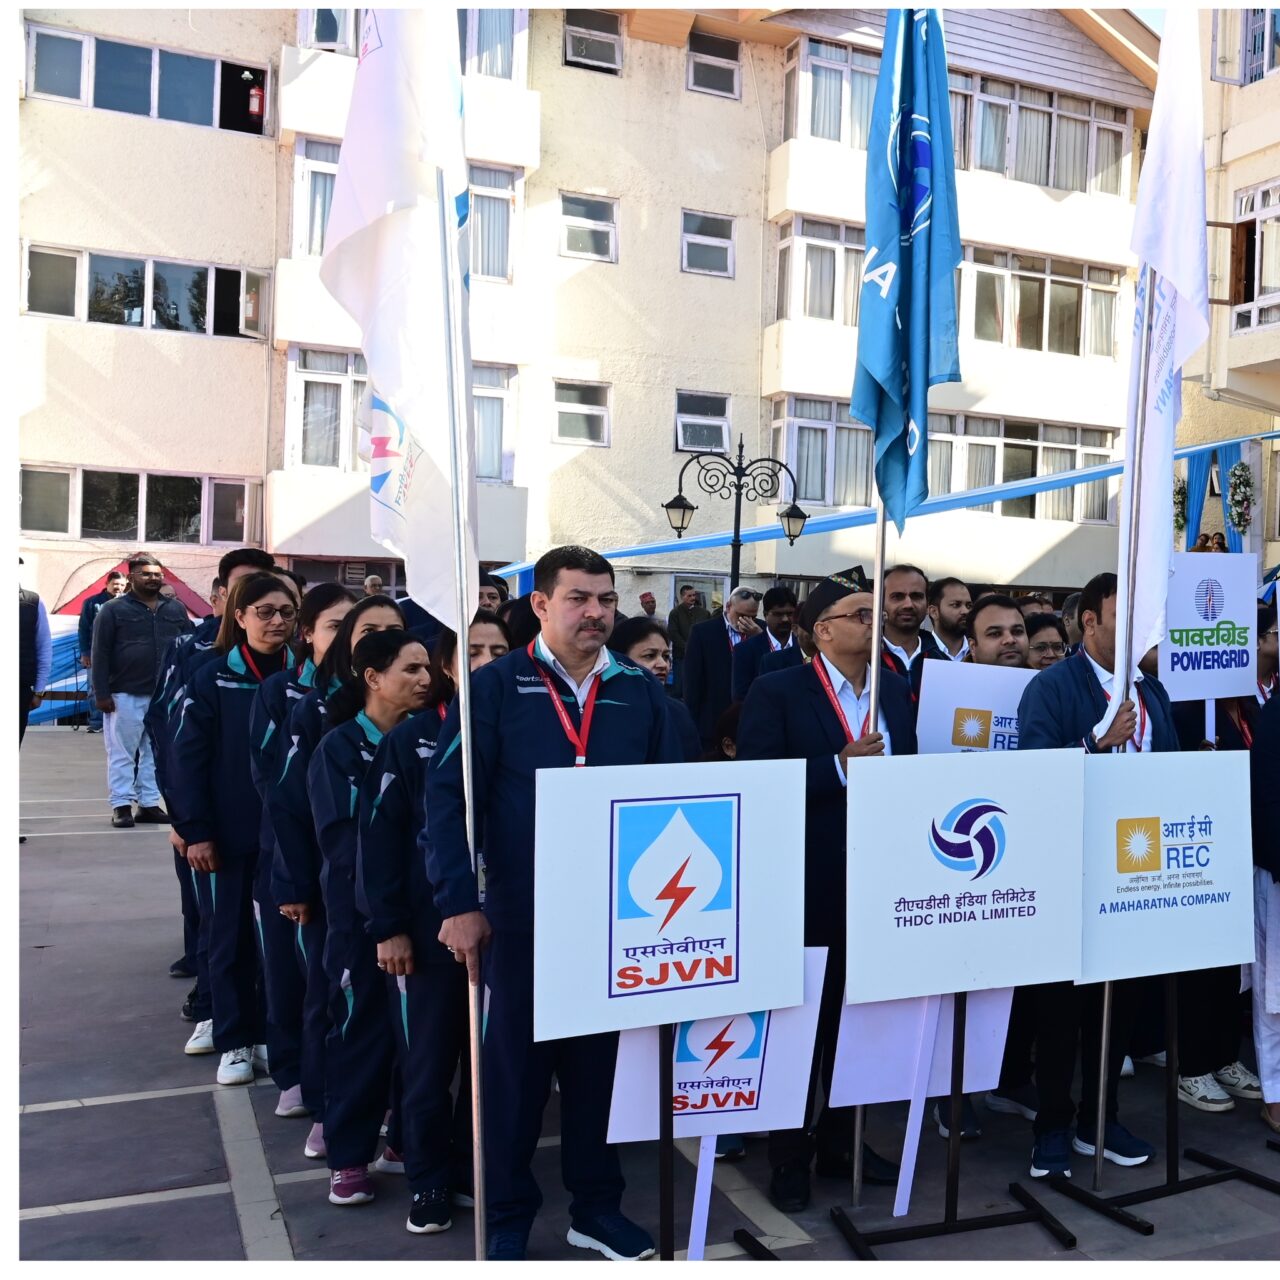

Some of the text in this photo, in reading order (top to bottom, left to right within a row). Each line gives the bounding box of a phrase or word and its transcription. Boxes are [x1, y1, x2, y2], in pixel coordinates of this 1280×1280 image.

[1169, 620, 1250, 647] पावरग्रिड
[1170, 649, 1250, 672] POWERGRID
[993, 733, 1019, 751] RE
[1163, 815, 1213, 841] आर ई सी
[1166, 845, 1210, 869] REC
[1117, 885, 1140, 894] Endless
[1162, 881, 1181, 890] Infinite
[894, 888, 1036, 913] टीएचडीसी इंडिया लिमिटेड
[1099, 891, 1231, 915] A MAHARATNA COMPANY
[894, 905, 1036, 928] THDC INDIA LIMITED
[623, 936, 727, 963] एसजेवीएन
[616, 955, 733, 989] SJVN
[677, 1076, 752, 1093] एसजेवीएन
[672, 1091, 755, 1111] SJVN
